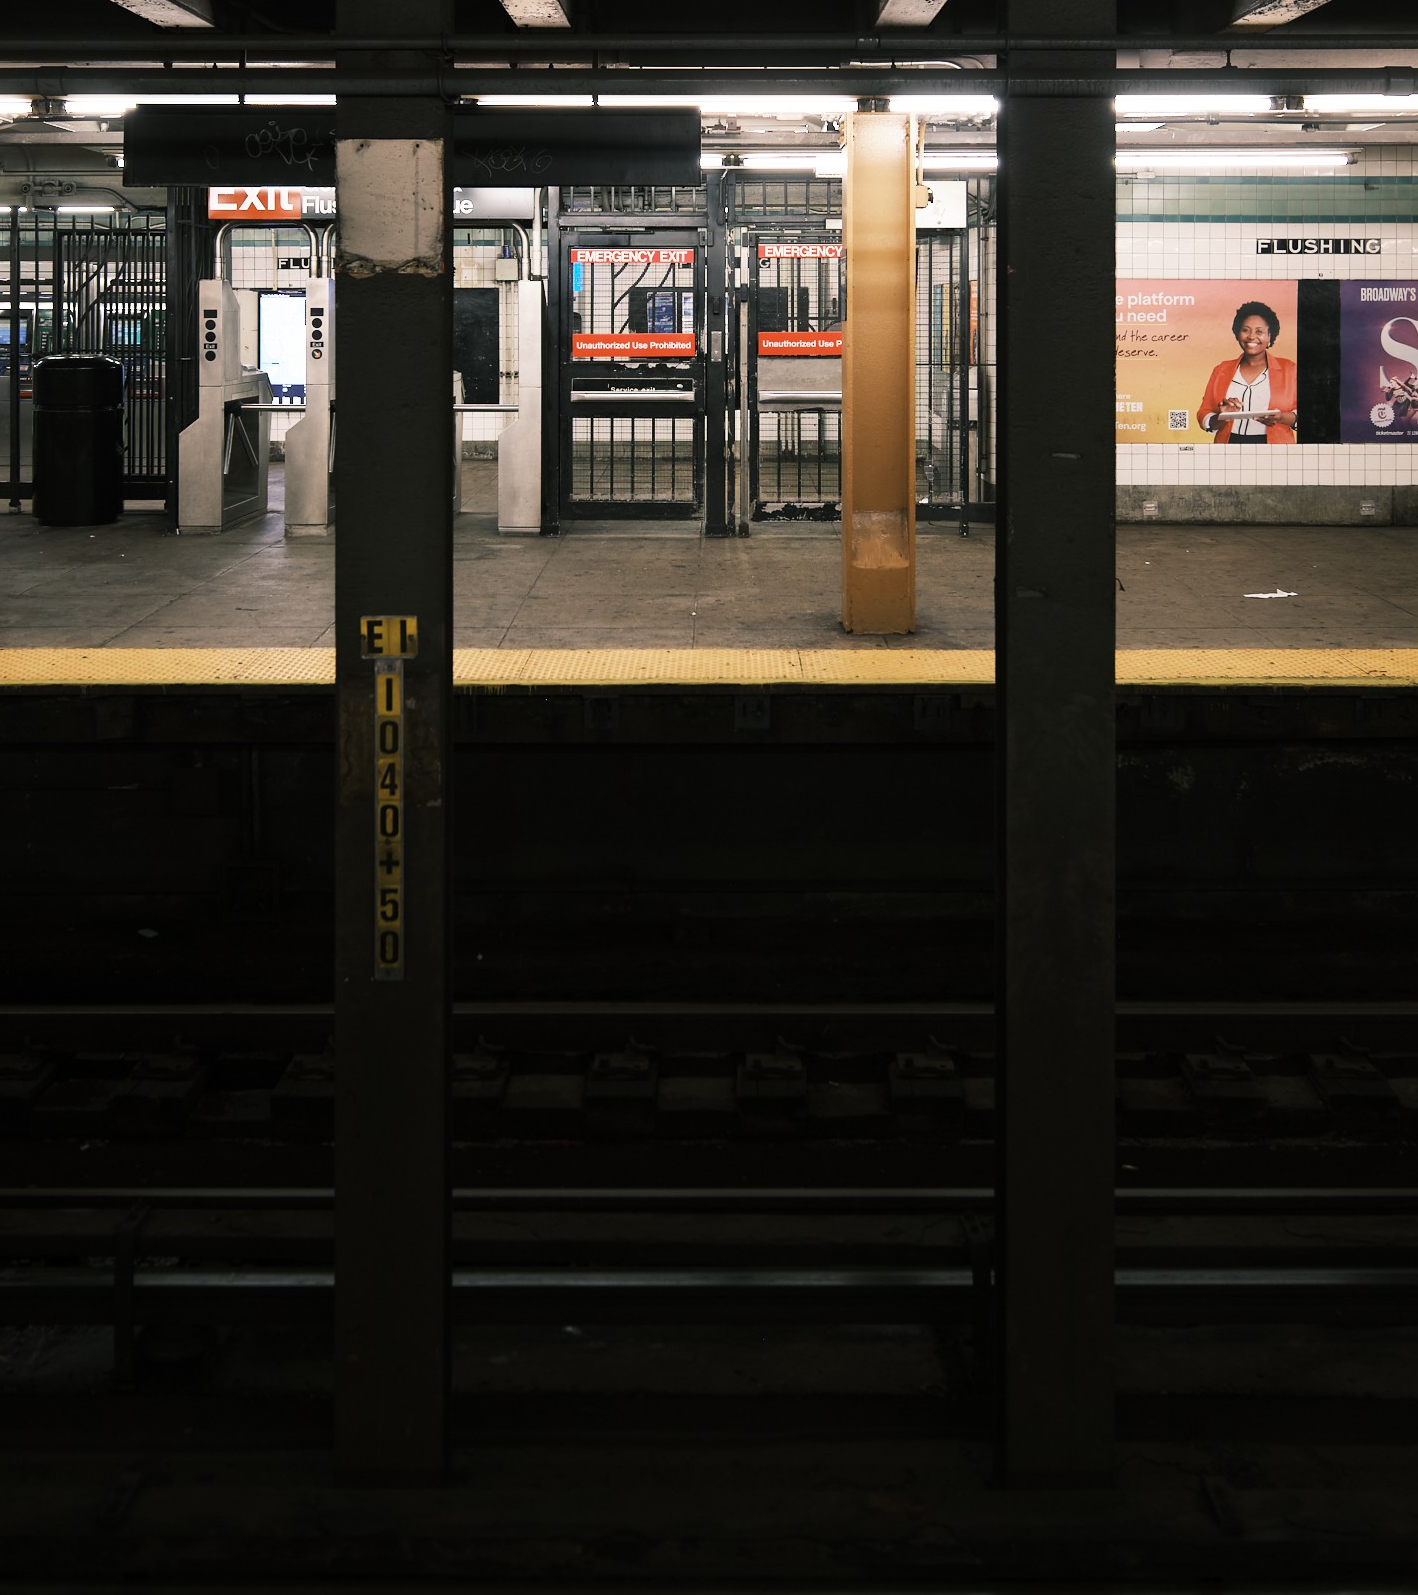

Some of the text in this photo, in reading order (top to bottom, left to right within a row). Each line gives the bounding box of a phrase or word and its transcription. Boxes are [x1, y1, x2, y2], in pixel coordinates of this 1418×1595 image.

[765, 245, 842, 257] EMERGENCY
[1257, 239, 1380, 254] FLUSHING
[577, 251, 687, 263] EMERGENCY EXIT
[1127, 292, 1195, 308] platform
[1361, 287, 1416, 302] BROADWAY'S
[1127, 309, 1167, 322] need
[1131, 329, 1148, 342] the
[1151, 332, 1189, 342] career
[576, 341, 691, 350] Unauthorized Use Prohibited
[763, 340, 817, 348] Unauthorized
[819, 340, 834, 348] Use
